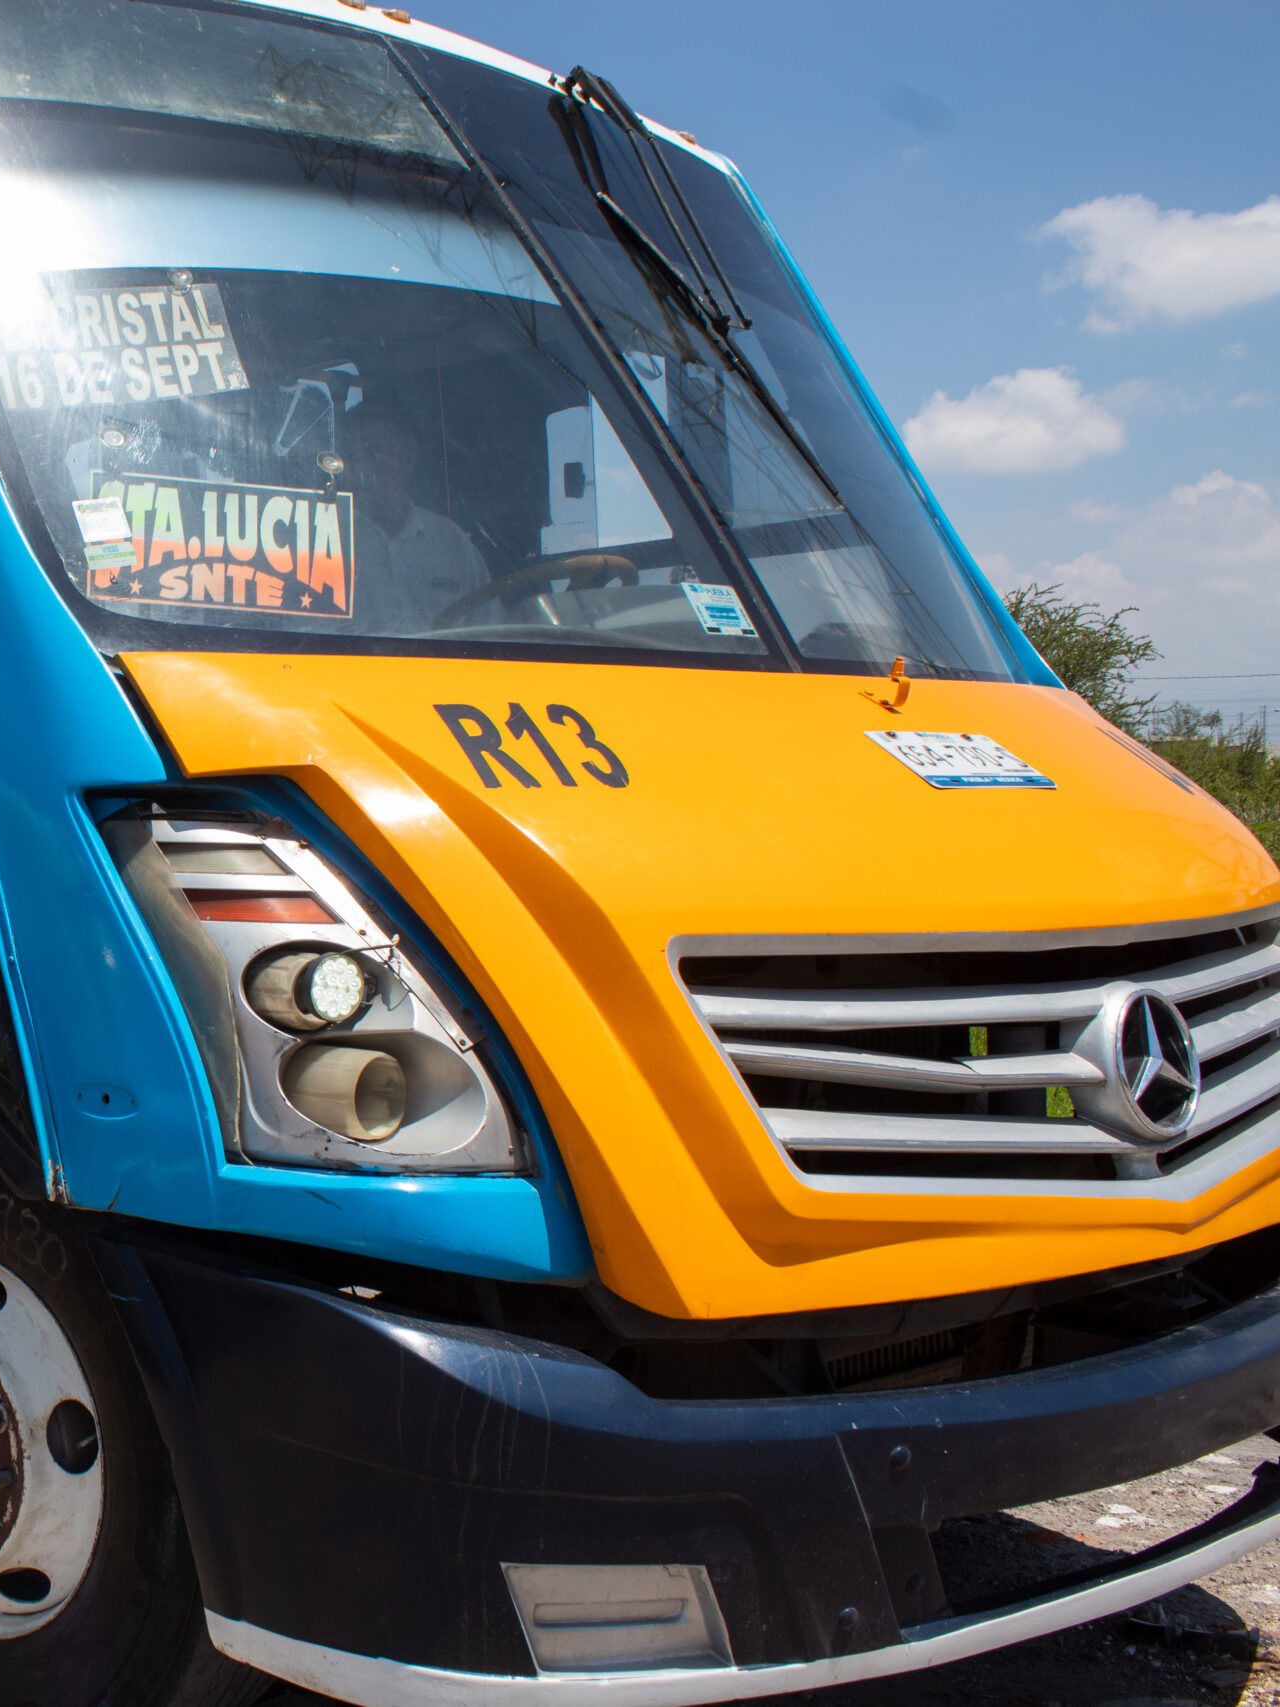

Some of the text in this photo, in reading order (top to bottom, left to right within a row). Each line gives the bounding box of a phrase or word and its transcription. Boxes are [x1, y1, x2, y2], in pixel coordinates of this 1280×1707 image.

[53, 350, 115, 406] DE
[121, 342, 239, 402] SEPT.
[158, 562, 286, 608] SNTE
[432, 702, 630, 789] R13
